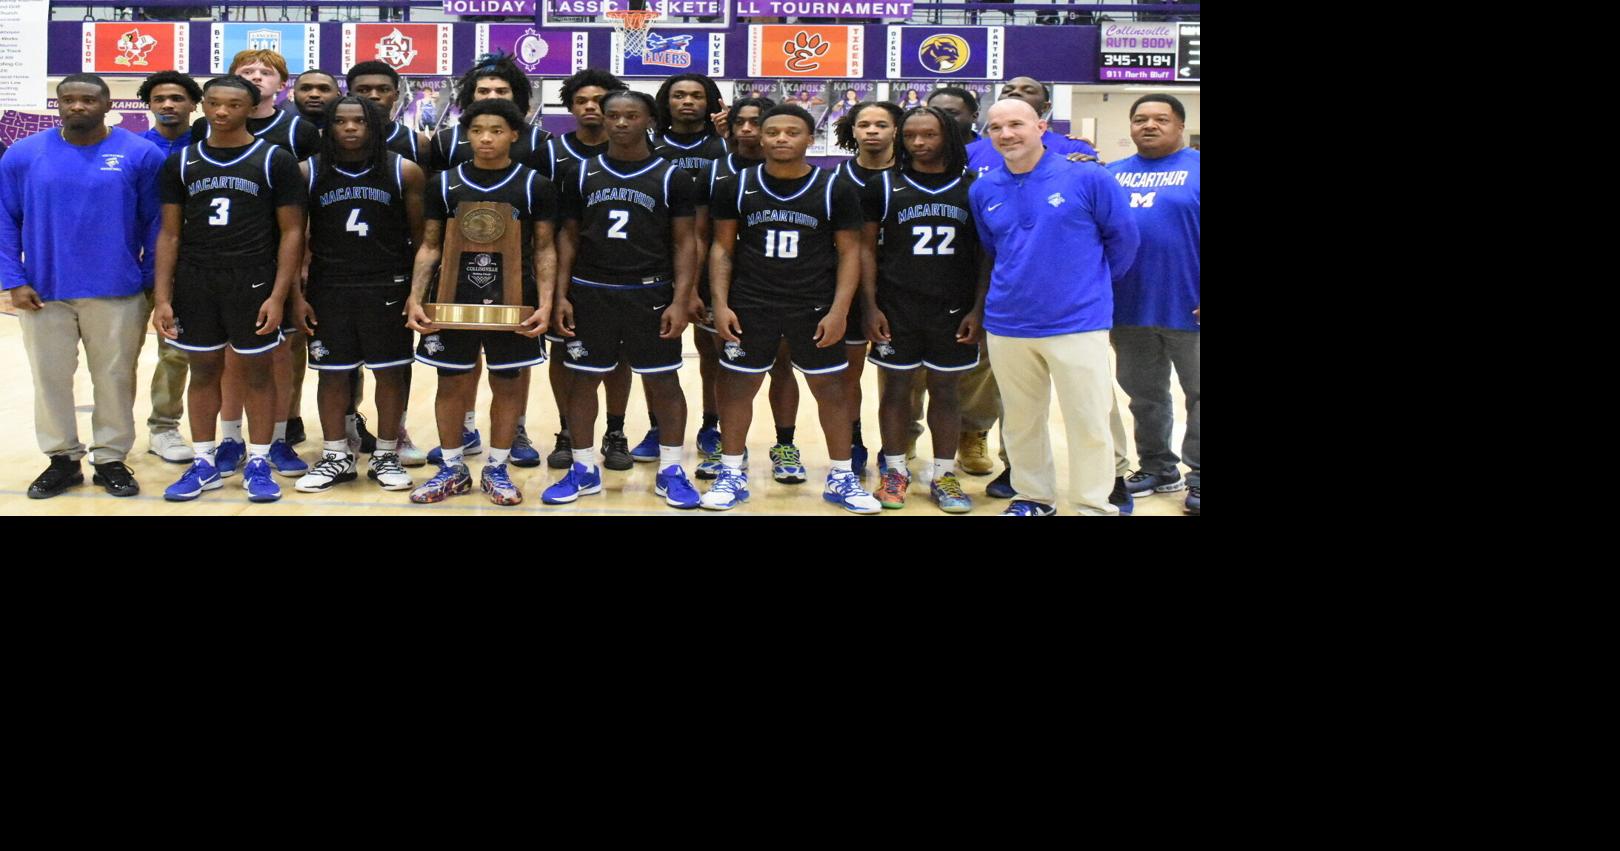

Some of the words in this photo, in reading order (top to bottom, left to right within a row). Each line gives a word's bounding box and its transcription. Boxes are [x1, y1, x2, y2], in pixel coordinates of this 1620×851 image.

[443, 1, 525, 12] HOLIDAY
[533, 1, 618, 12] LASSIC
[770, 2, 911, 14] TOURNAMENT
[1106, 24, 1169, 36] Collinsville
[1106, 37, 1137, 48] AUTO
[1142, 37, 1174, 48] BODY
[645, 51, 688, 65] FLYERS
[851, 28, 859, 75] TIGERS
[1104, 55, 1171, 66] 345-1194
[1106, 70, 1122, 78] 911
[1125, 70, 1147, 78] North
[1150, 70, 1169, 78] Bluff
[738, 82, 777, 92] KAHOKS
[786, 82, 826, 92] KAHOKS
[833, 82, 874, 92] KAHOKS
[892, 82, 933, 92] KAHOKS
[188, 176, 259, 197] MACARTHUR
[319, 186, 392, 207] MACARTHUR
[1129, 192, 1156, 208] M
[208, 197, 230, 225] 3
[747, 209, 819, 229] MACARTHUR
[898, 203, 968, 224] MACARTHUR
[345, 208, 369, 237] 4
[607, 210, 629, 239] 2
[765, 230, 799, 258] 10
[913, 226, 956, 255] 22
